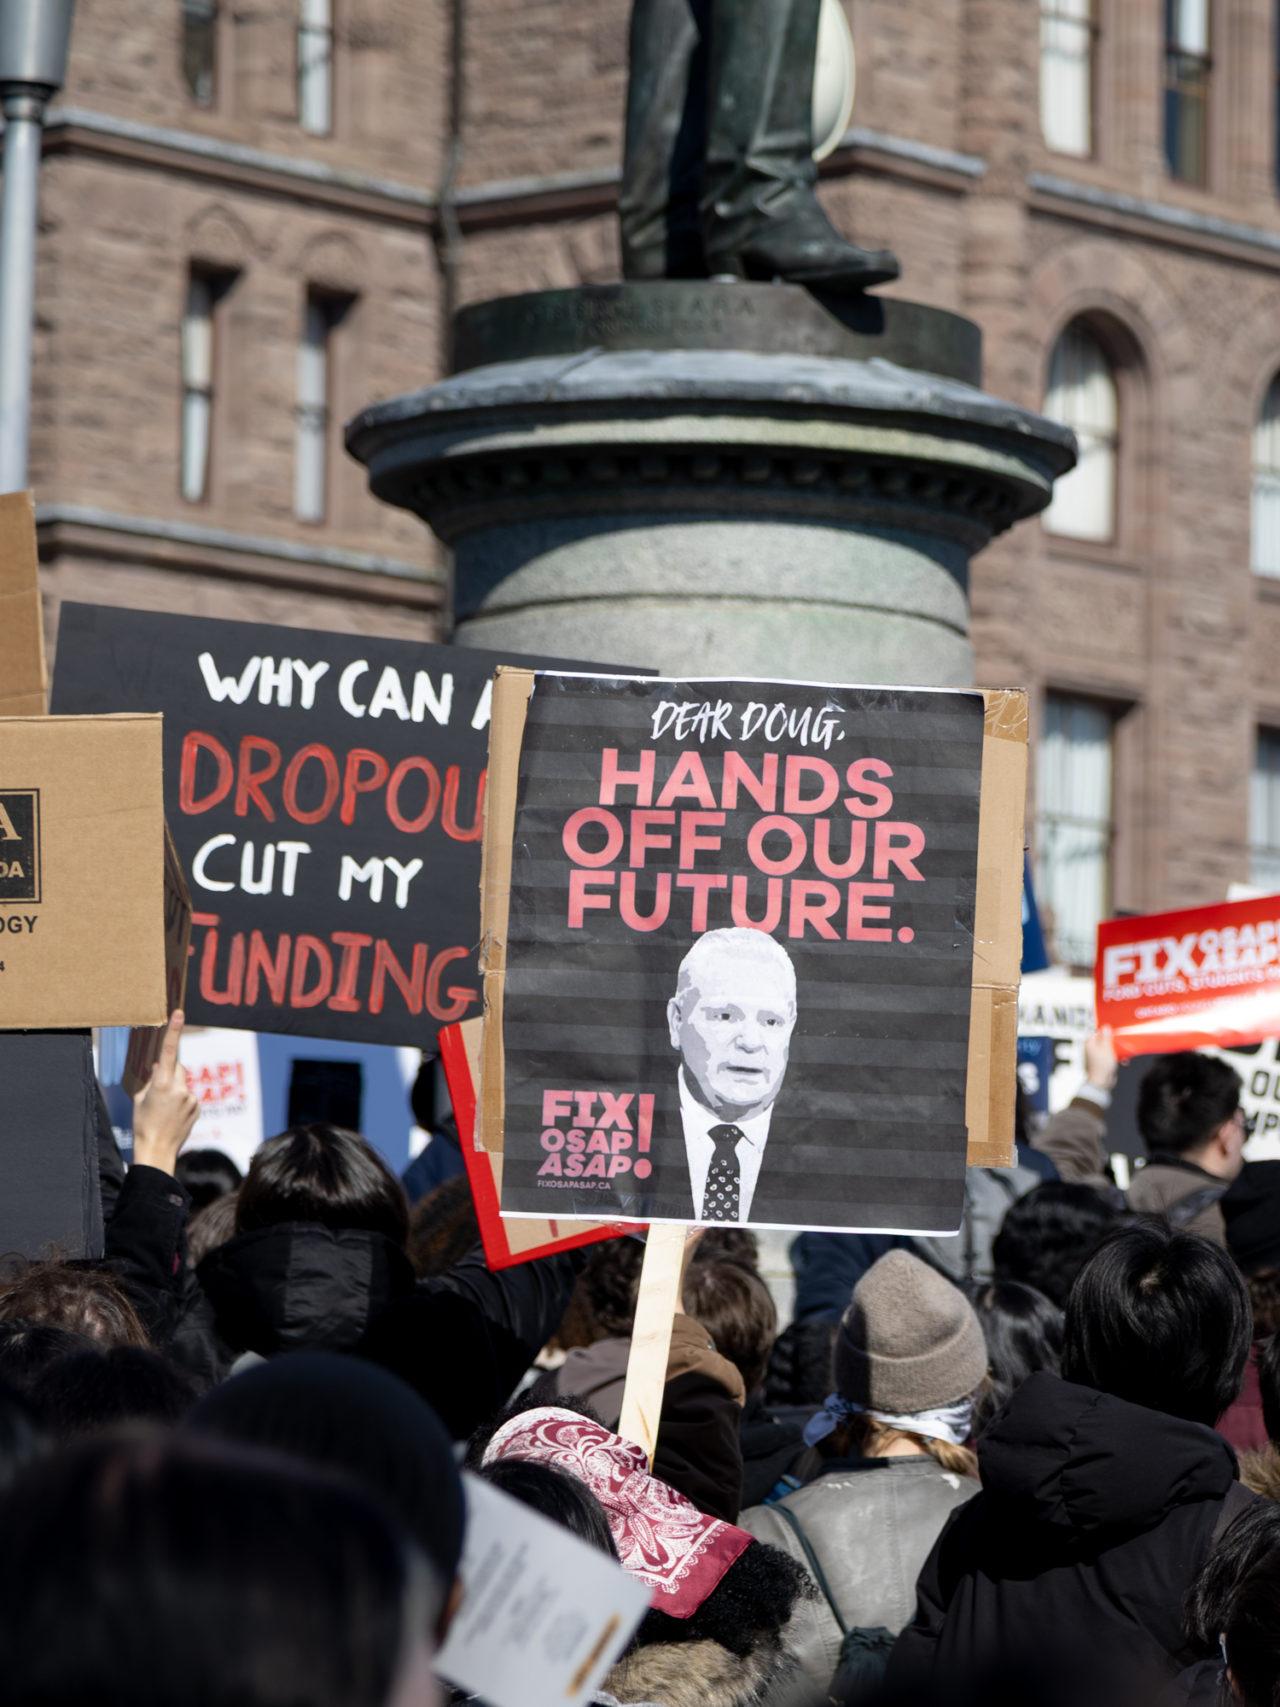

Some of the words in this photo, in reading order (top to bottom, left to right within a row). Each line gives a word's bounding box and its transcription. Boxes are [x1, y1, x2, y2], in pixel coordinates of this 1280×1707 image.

[198, 652, 330, 710] WHY
[338, 659, 455, 726] CAN
[650, 699, 733, 743] DEAR
[739, 700, 846, 750] DOUG,
[179, 731, 488, 841] DROPOU
[599, 747, 895, 819] HANDS
[192, 833, 312, 896] CUT
[338, 855, 424, 909] MY
[562, 807, 727, 870] OFF
[747, 814, 926, 882] OUR
[567, 869, 915, 944] FUTURE.
[1103, 932, 1199, 988] FIX
[540, 1128, 634, 1155] OSAP
[541, 1089, 636, 1131] FIX
[537, 1180, 612, 1191] FIXOSAPASAP.CA
